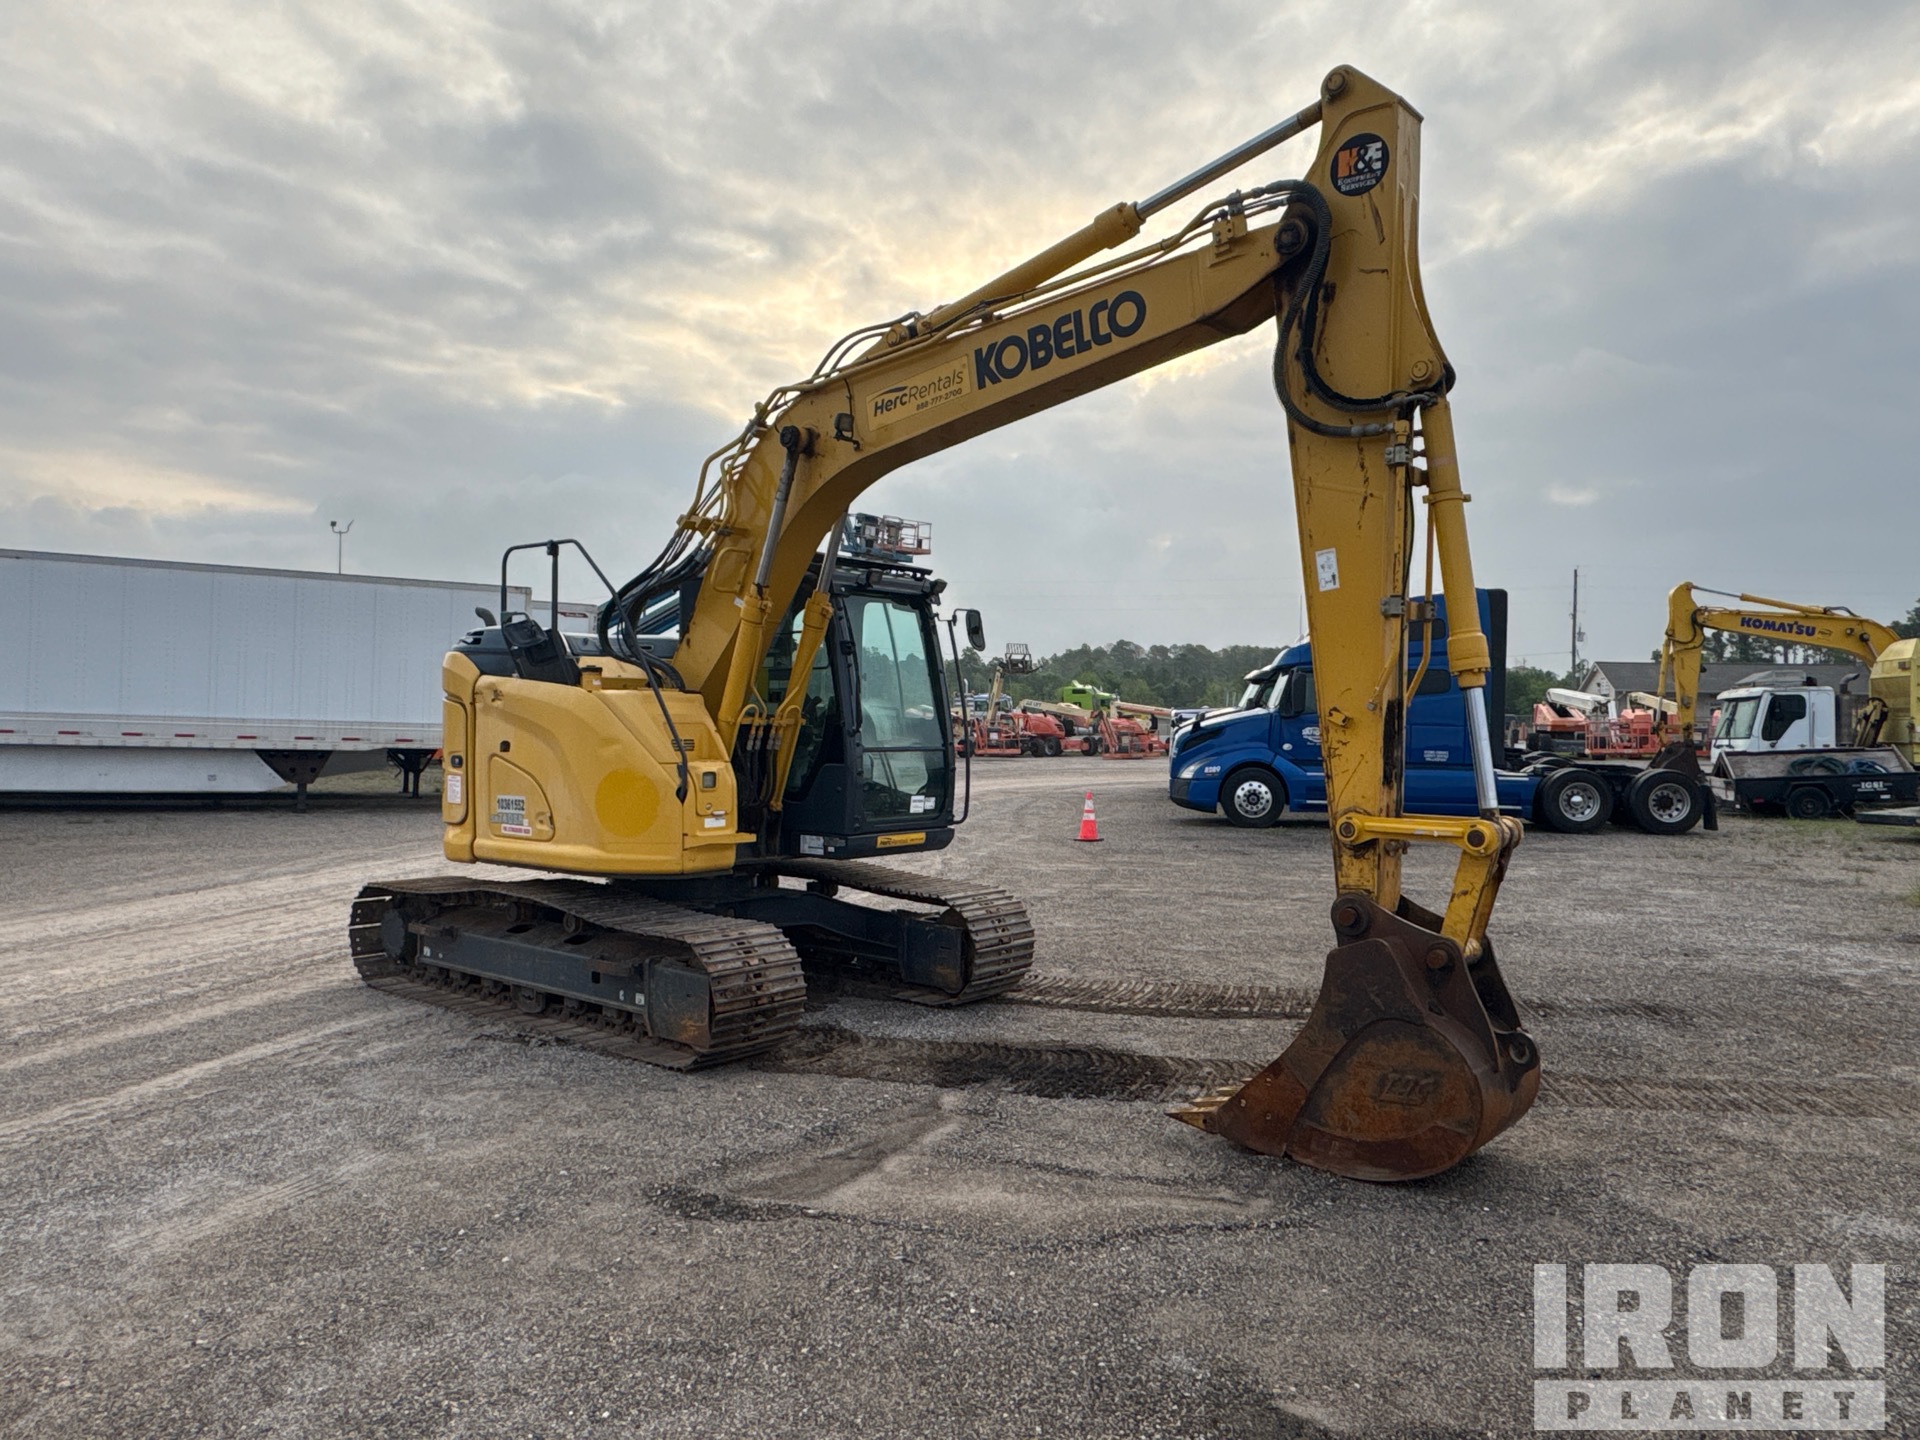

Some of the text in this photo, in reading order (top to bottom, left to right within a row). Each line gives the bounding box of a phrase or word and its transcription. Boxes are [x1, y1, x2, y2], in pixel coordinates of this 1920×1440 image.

[1340, 178, 1377, 192] SERVICES
[974, 290, 1147, 390] KOBELCO
[874, 369, 964, 417] HercRentals
[1740, 616, 1817, 637] KOMATSU
